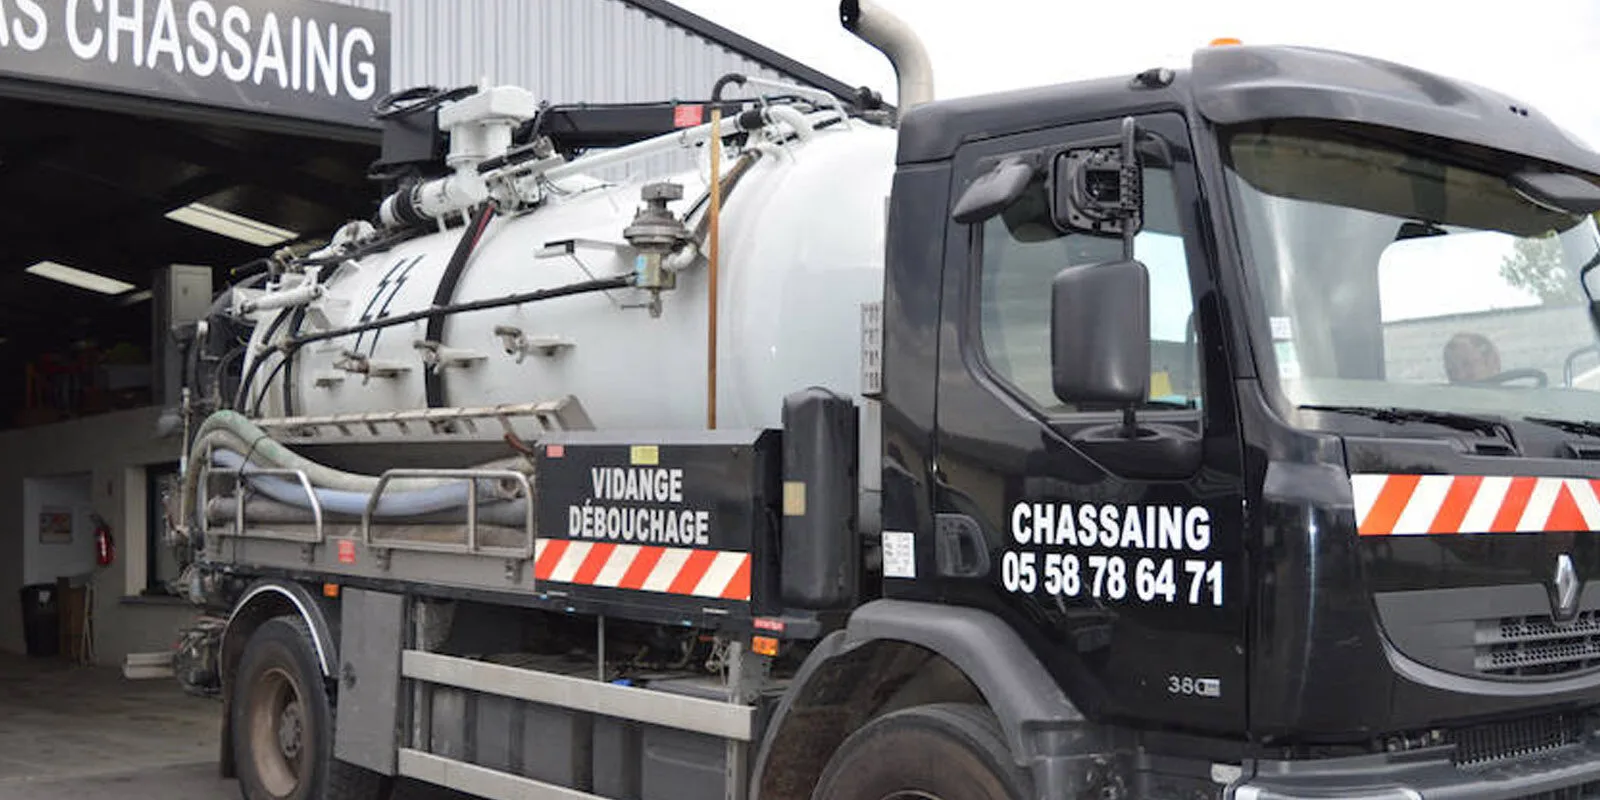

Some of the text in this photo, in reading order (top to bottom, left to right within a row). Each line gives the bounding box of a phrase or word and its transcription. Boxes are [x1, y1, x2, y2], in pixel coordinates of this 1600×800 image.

[0, 0, 376, 100] S CHASSAING
[592, 467, 683, 502] VIDANGE
[568, 499, 709, 545] DÉBOUCHAGE
[1012, 502, 1211, 551] CHASSAING
[1002, 551, 1223, 606] 05 58 78 64 71
